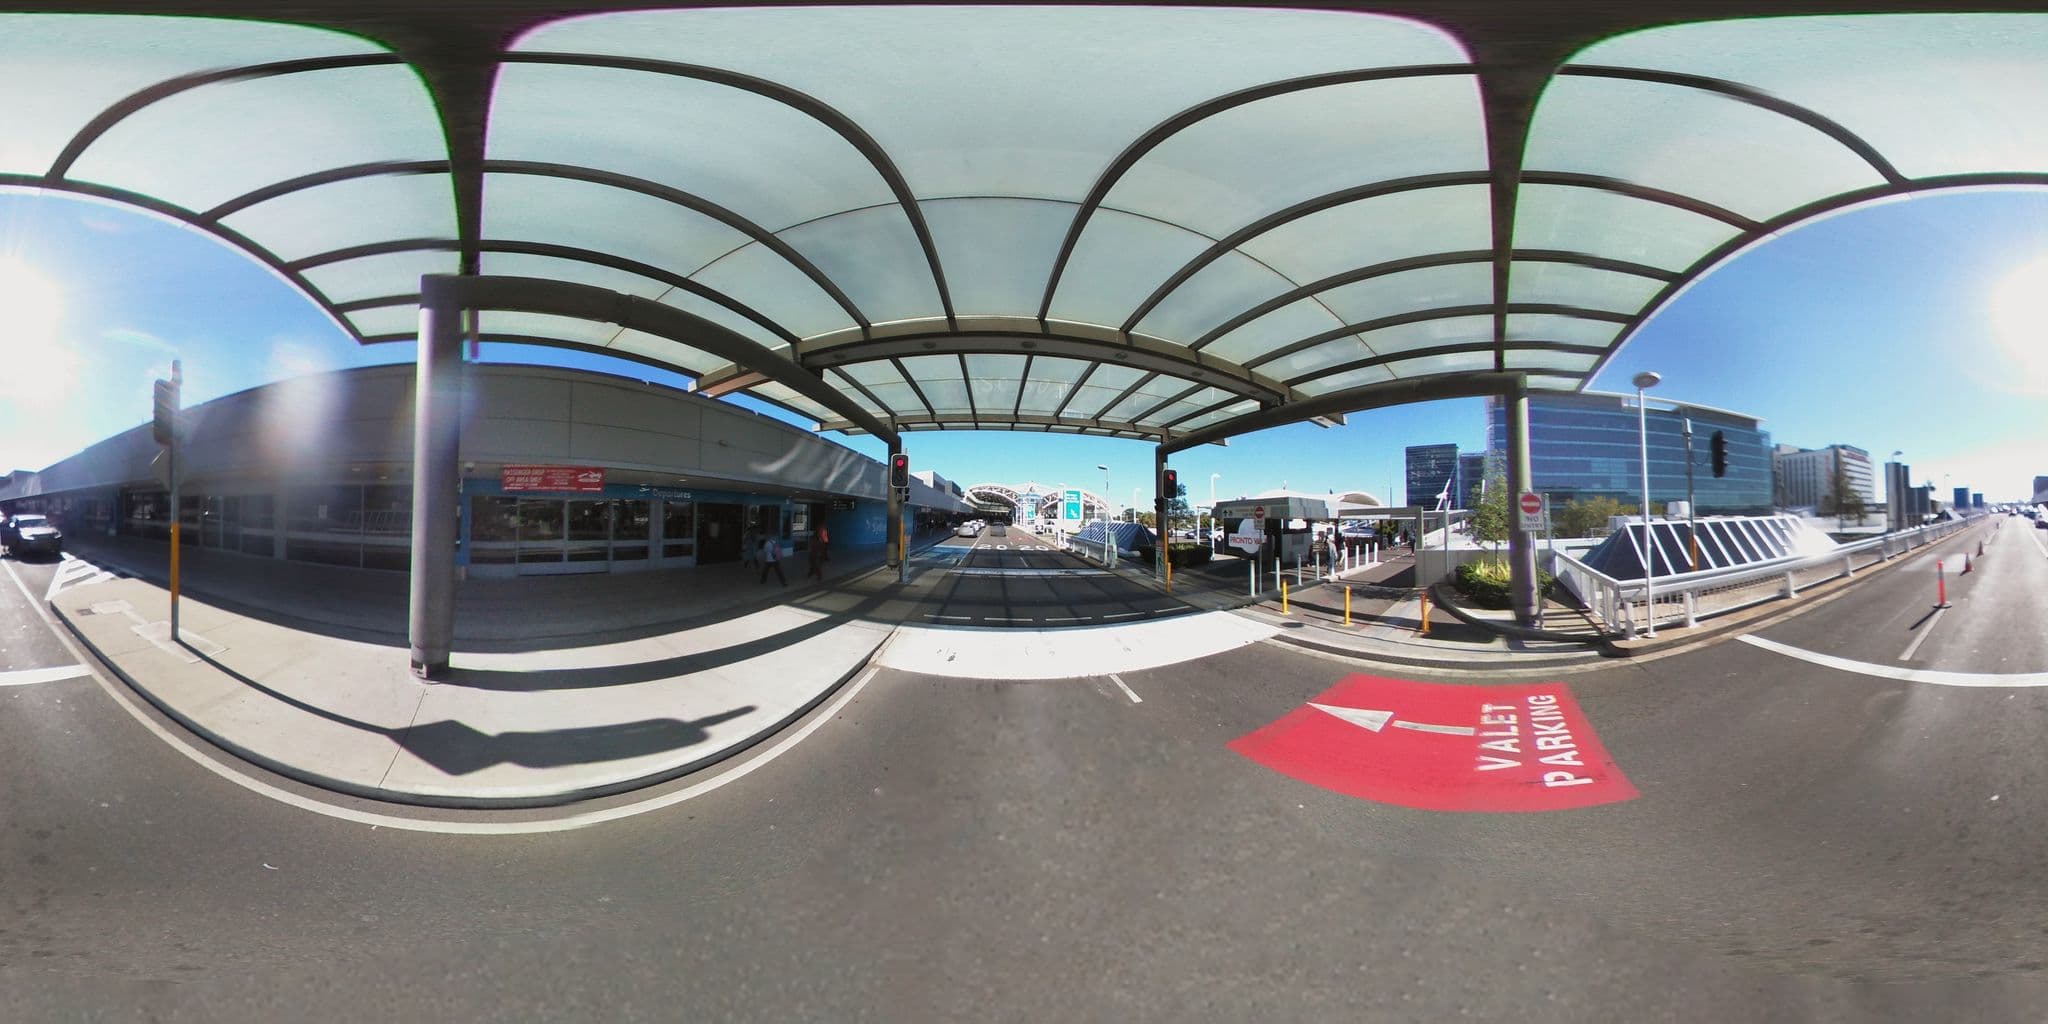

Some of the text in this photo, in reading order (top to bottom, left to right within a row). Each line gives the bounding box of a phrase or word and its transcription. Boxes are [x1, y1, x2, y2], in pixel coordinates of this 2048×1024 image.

[652, 488, 691, 499] Departures
[1474, 703, 1522, 772] VALET
[1527, 694, 1594, 788] PARKING
